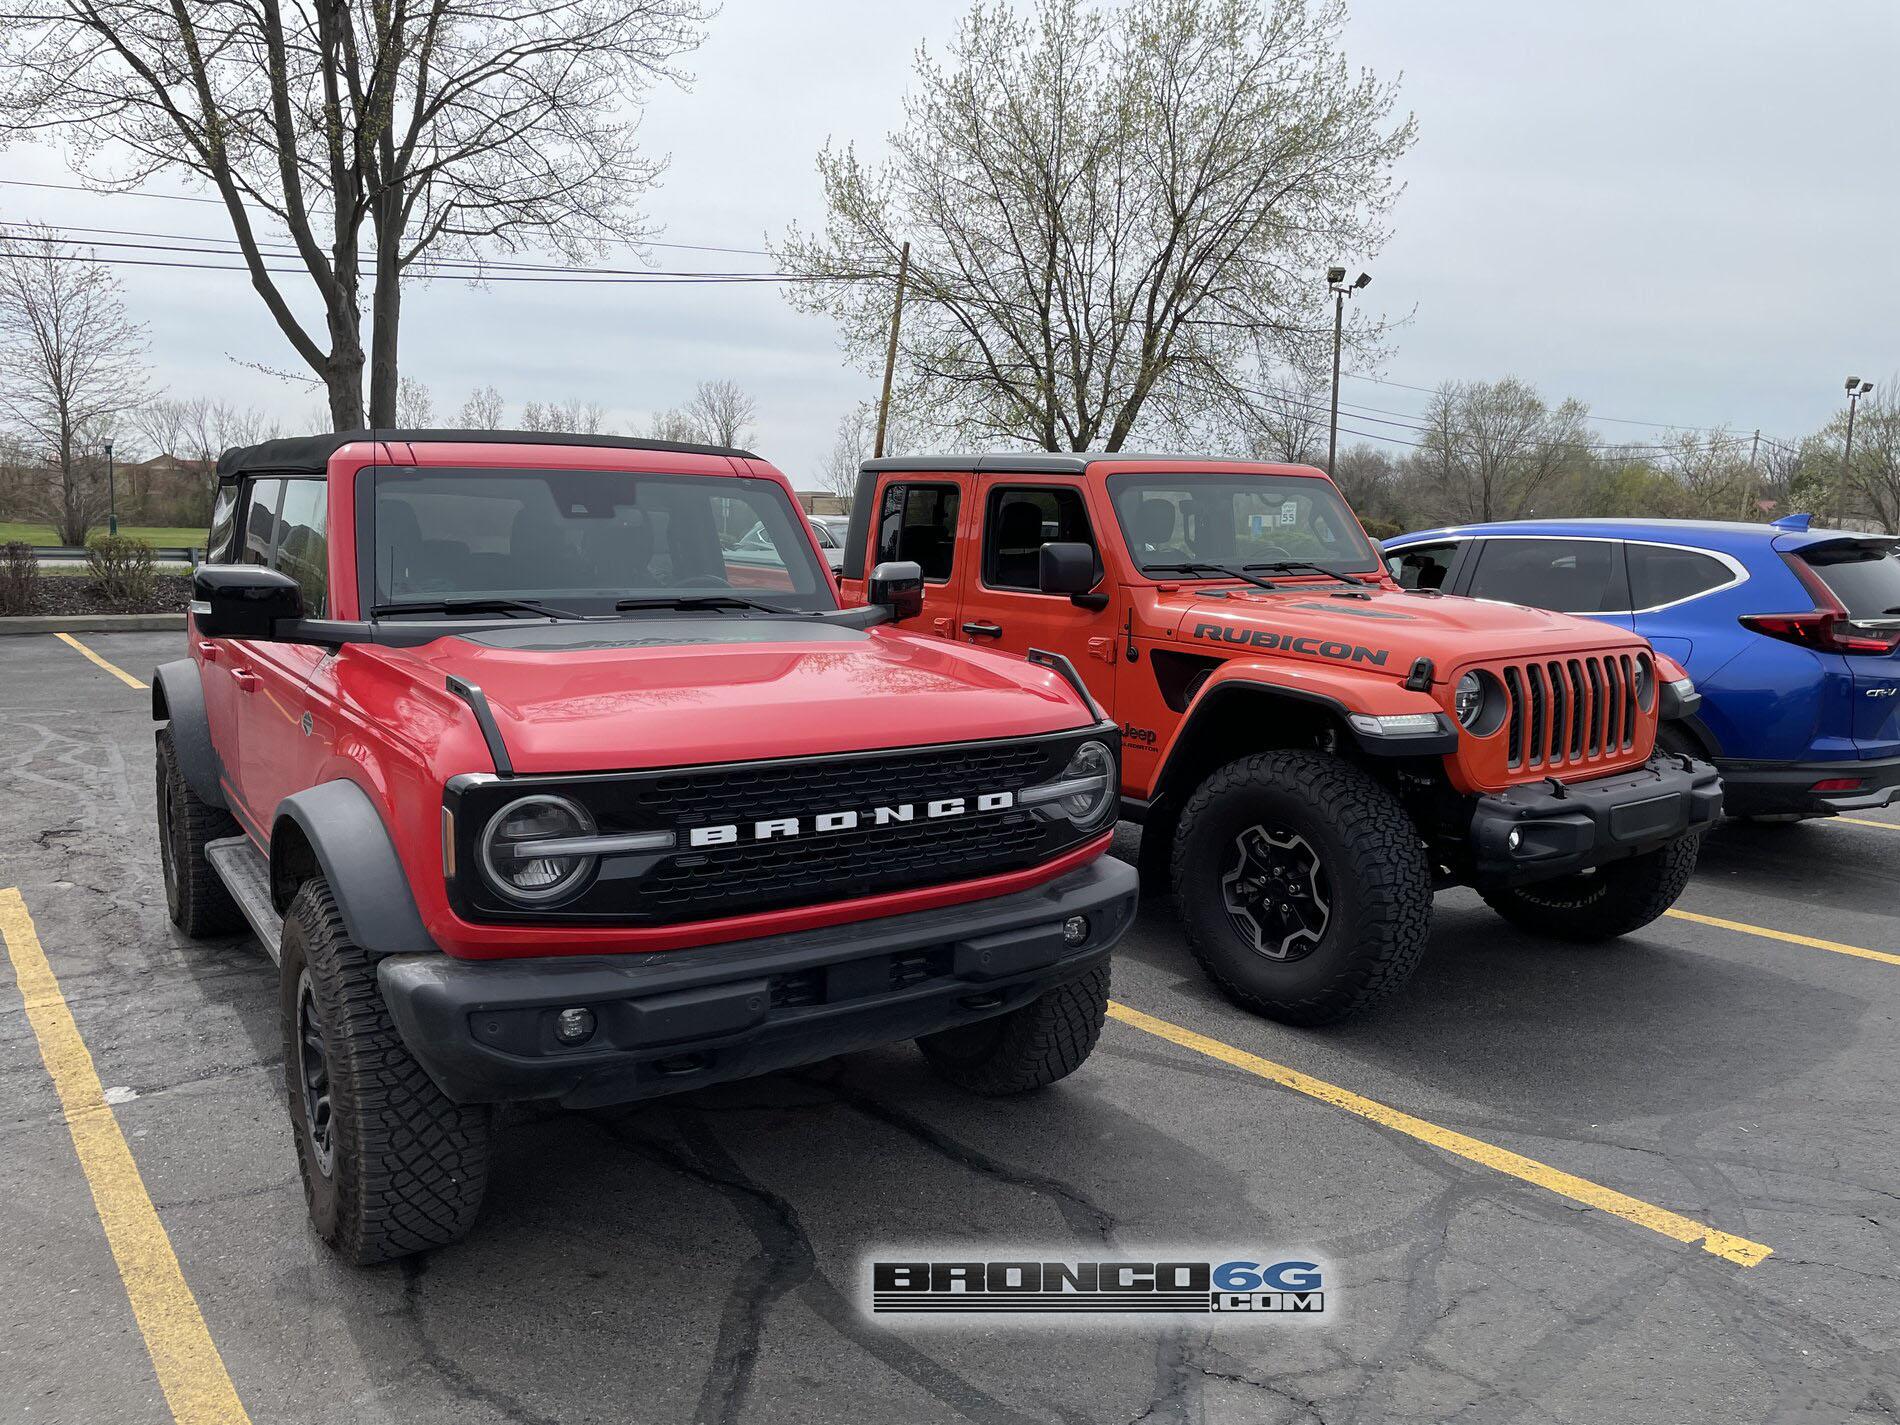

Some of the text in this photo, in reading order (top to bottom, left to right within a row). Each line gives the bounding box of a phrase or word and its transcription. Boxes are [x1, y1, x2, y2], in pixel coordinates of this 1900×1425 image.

[1194, 623, 1389, 666] RUBICON
[1122, 722, 1157, 745] Jeep
[690, 791, 1013, 847] BRONCO
